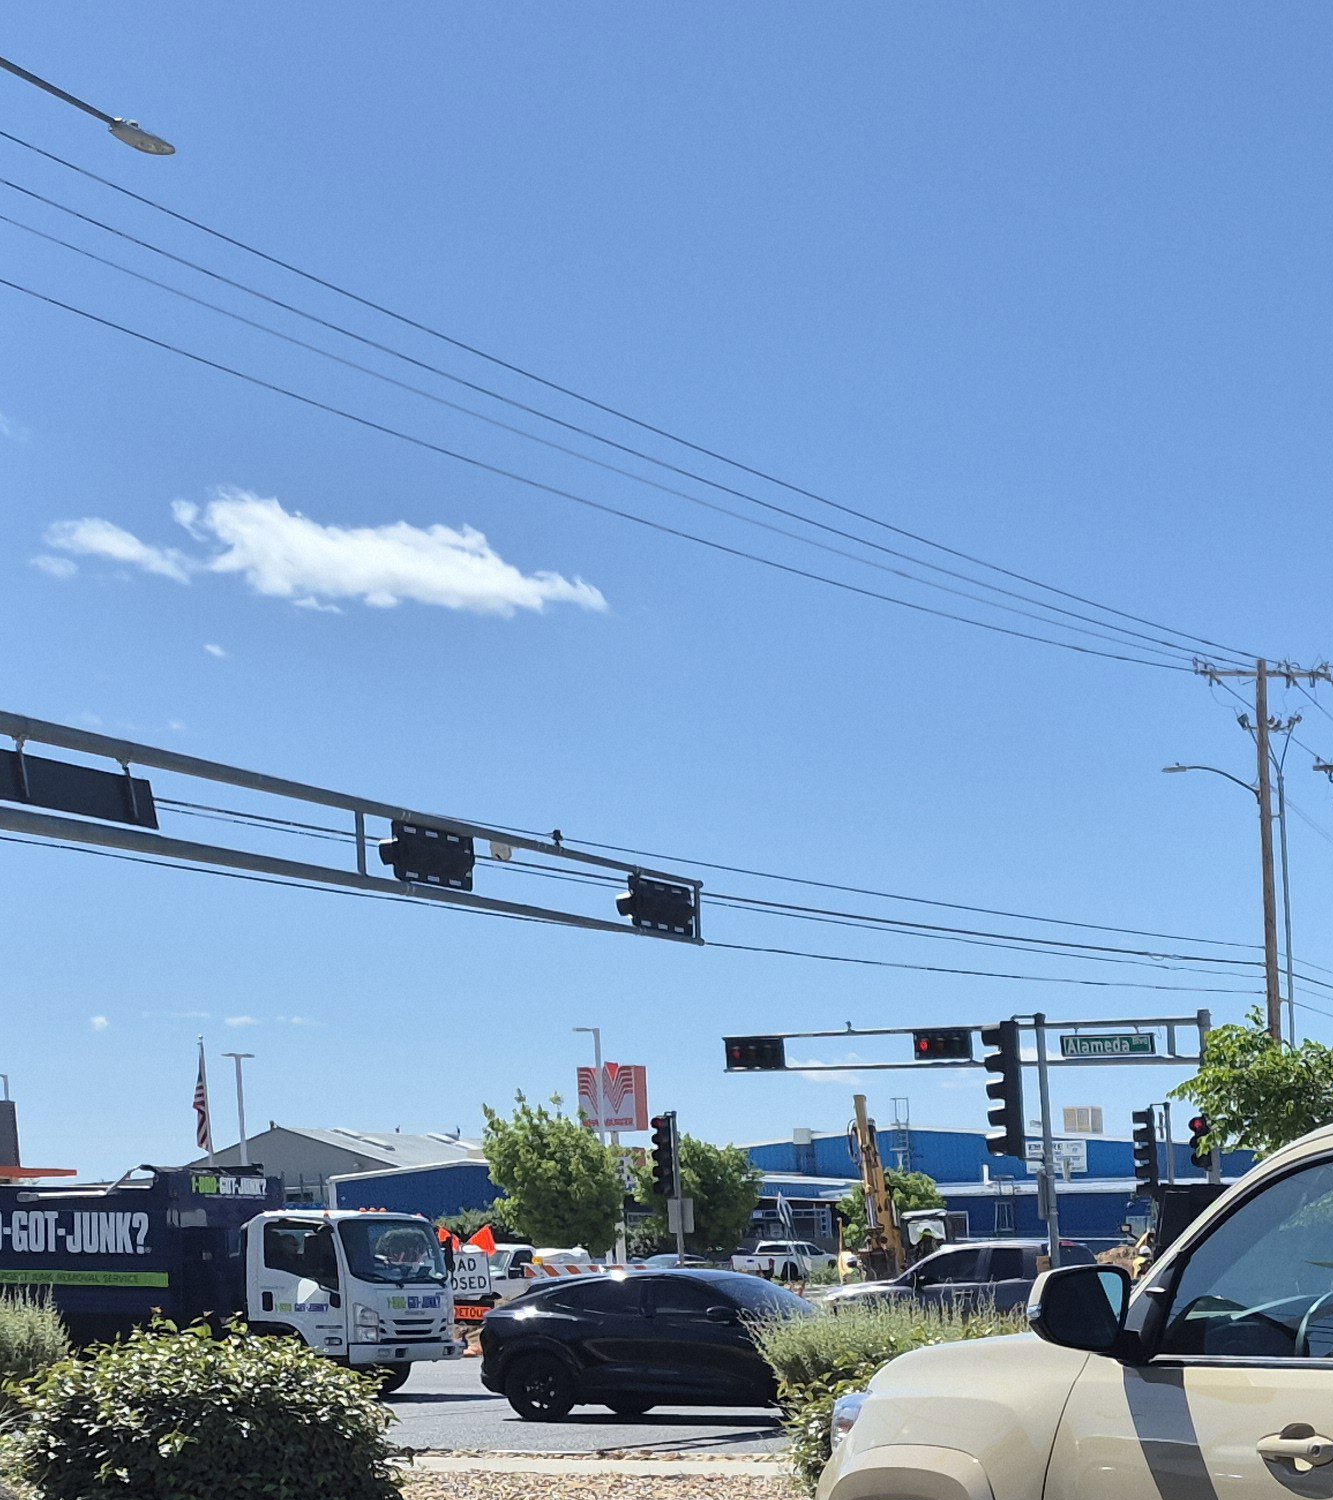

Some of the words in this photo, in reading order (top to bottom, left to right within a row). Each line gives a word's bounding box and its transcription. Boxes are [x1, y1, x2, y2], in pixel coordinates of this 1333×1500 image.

[1067, 1036, 1130, 1055] Alameda
[0, 1210, 149, 1255] -GOT-JUNK?
[453, 1257, 476, 1272] AD
[451, 1275, 487, 1291] OSED
